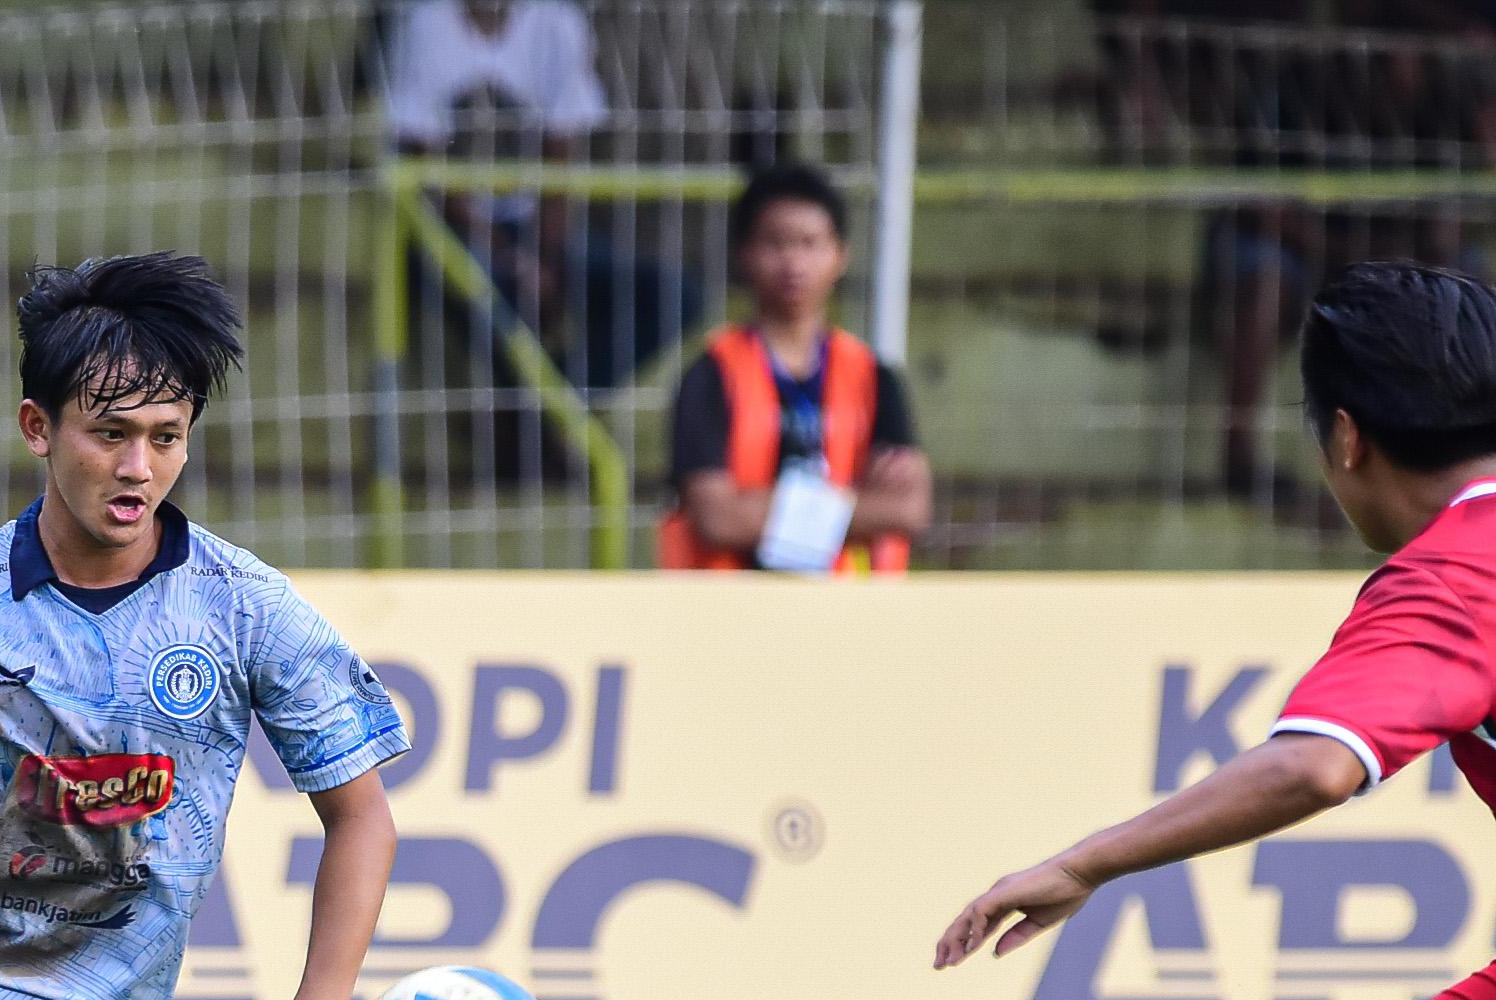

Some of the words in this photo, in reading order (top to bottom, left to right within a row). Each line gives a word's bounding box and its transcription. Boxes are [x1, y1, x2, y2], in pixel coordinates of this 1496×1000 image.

[190, 566, 228, 577] RADAR
[231, 569, 269, 583] KEDIRI
[156, 652, 197, 687] PERSEDIKAB
[198, 658, 213, 690] KEDIRI
